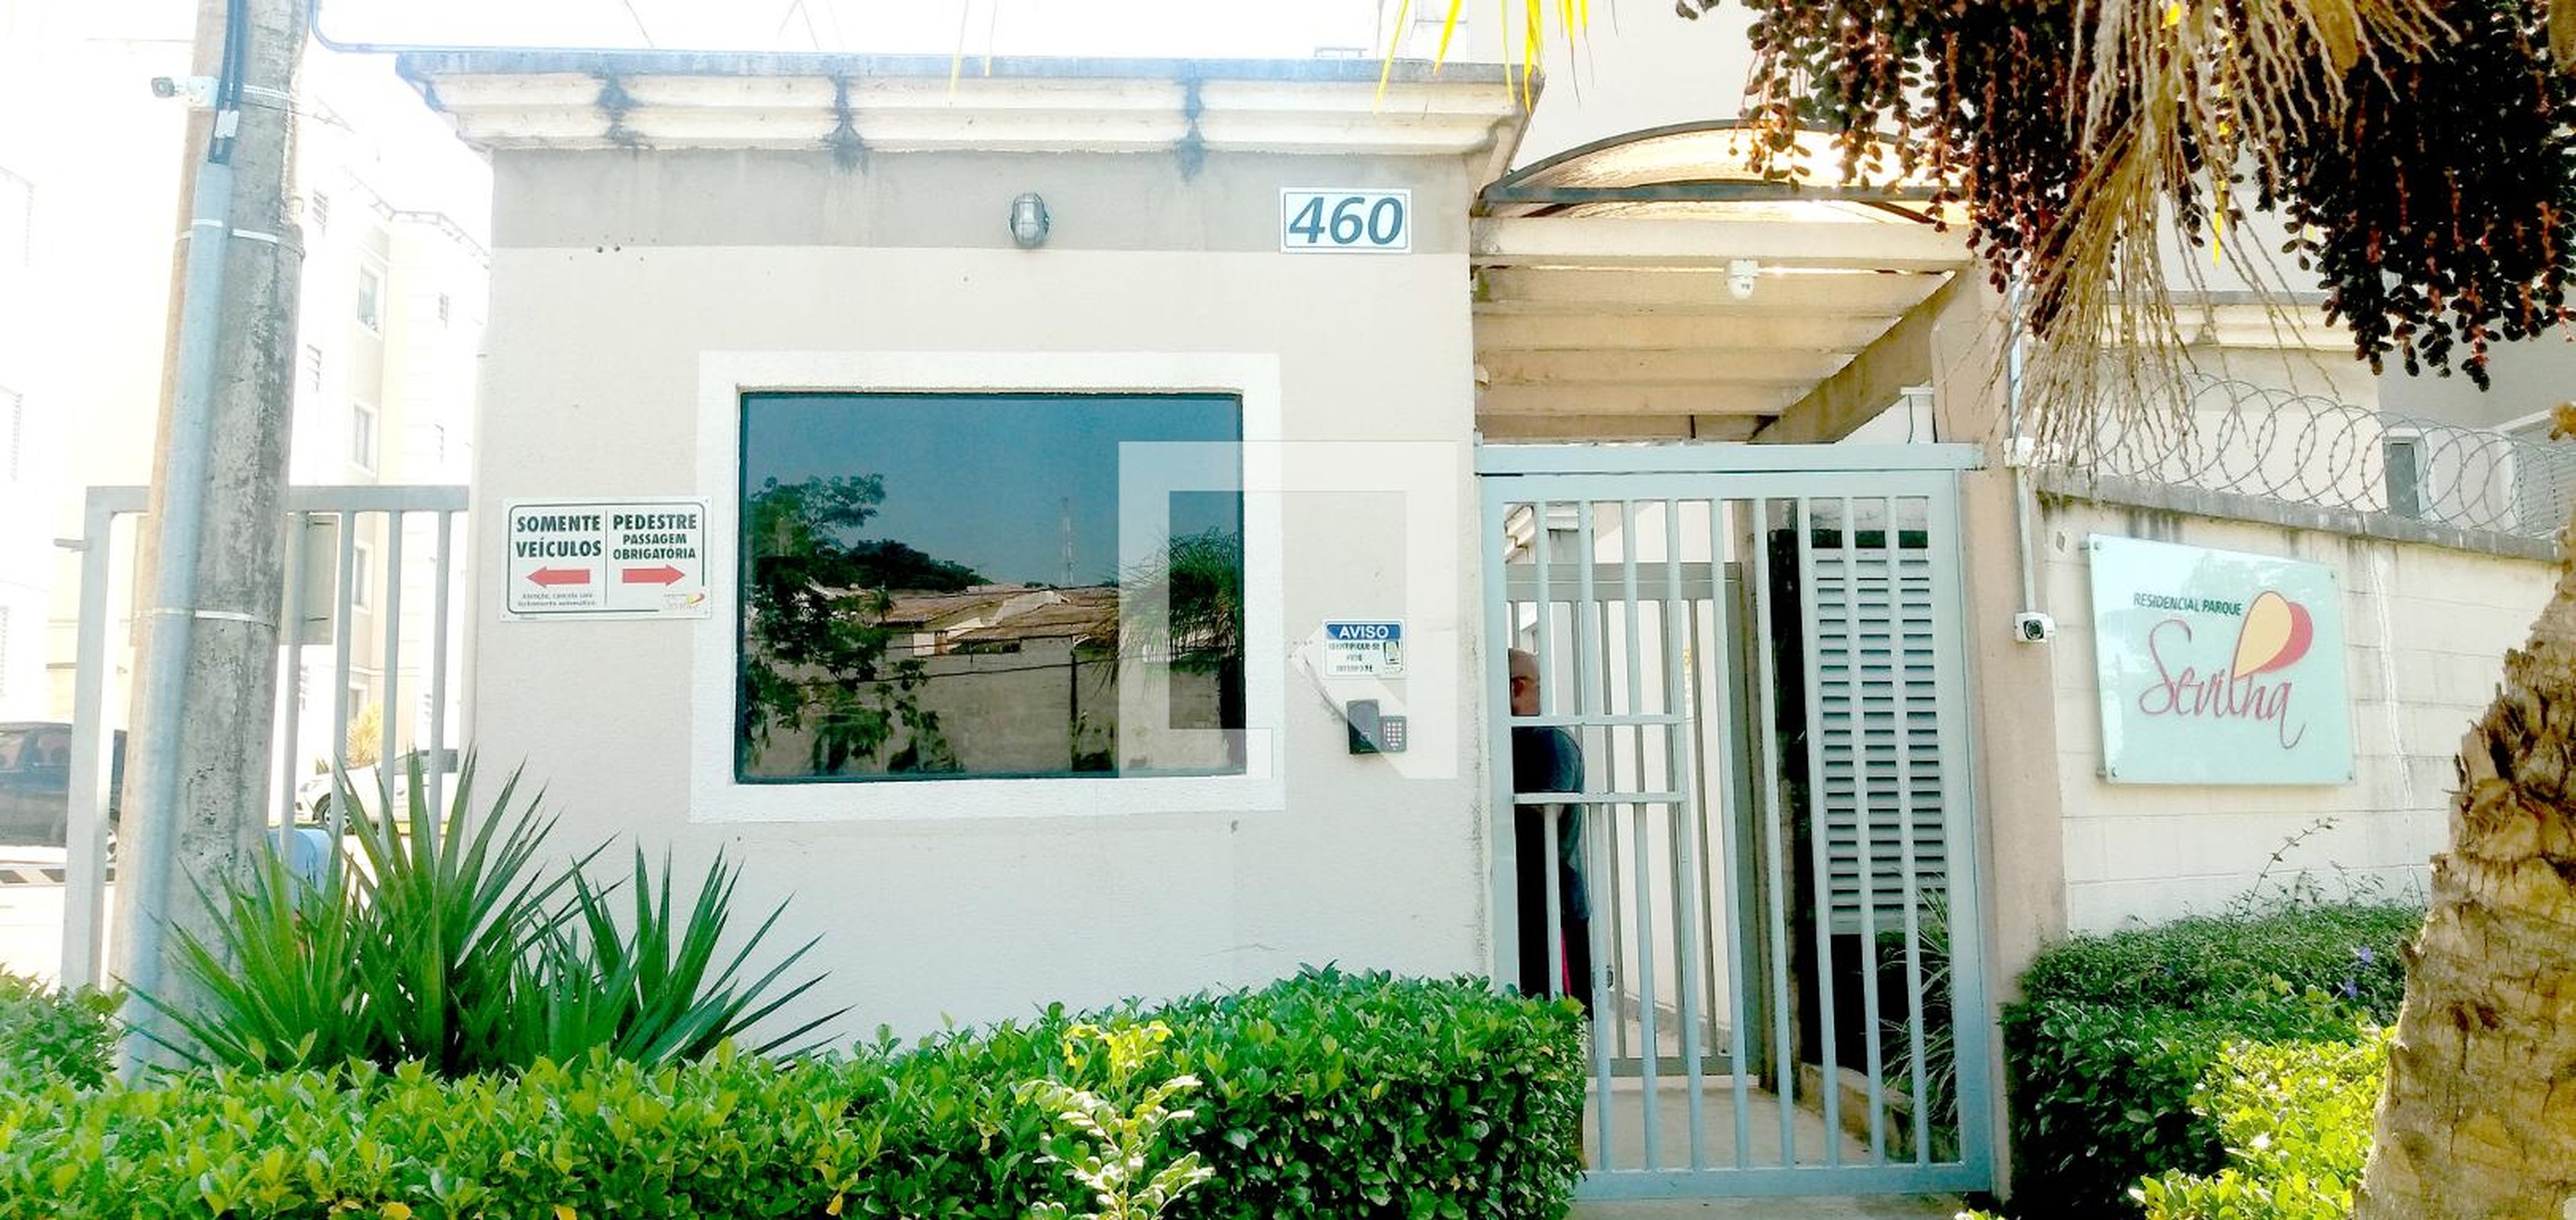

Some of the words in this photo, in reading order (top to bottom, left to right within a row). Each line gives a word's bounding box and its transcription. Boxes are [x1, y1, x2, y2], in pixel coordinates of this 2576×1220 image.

[1289, 197, 1403, 245] 460
[516, 515, 601, 533] SOMENTE
[613, 514, 697, 530] PEDESTRE
[516, 537, 602, 558] VEÍCULOS
[623, 533, 687, 545] PASSAGEM
[613, 545, 696, 560] OBRIGATÓRIA
[2133, 592, 2200, 612] RESIDENCIAL
[2201, 599, 2243, 616] PARQUE
[1339, 626, 1389, 639] AVISO
[2139, 591, 2306, 749] Sevilha
